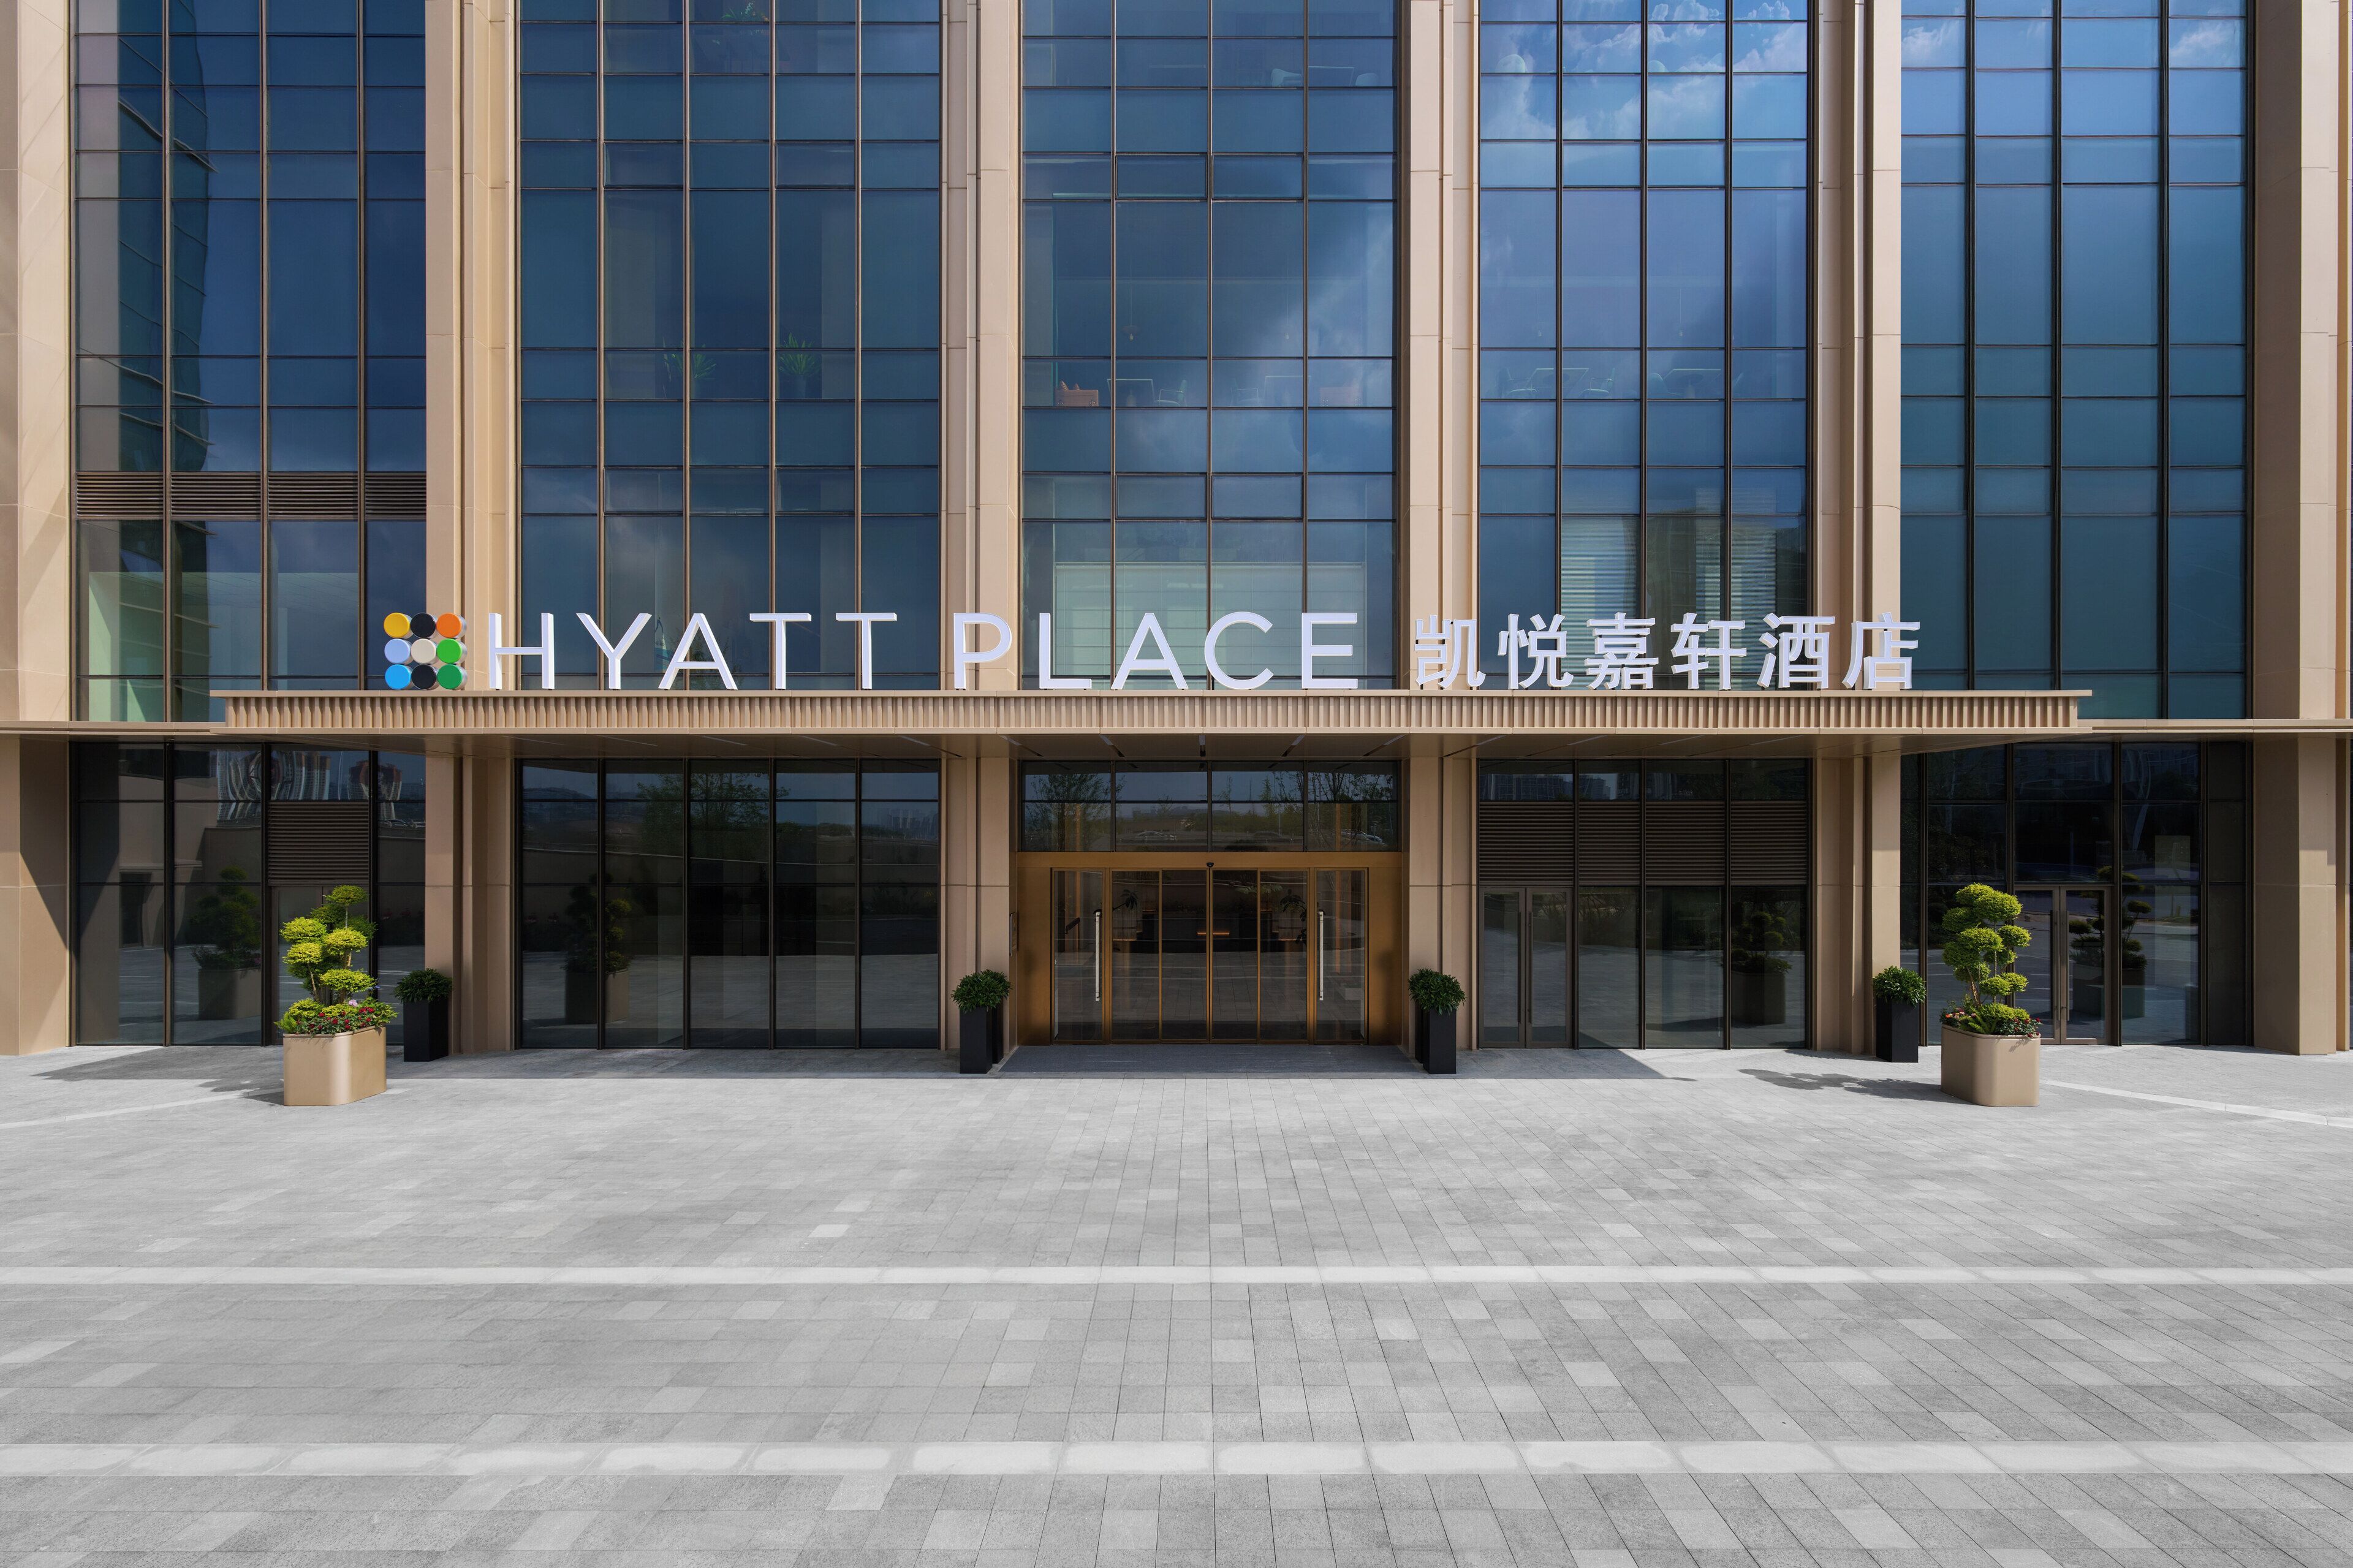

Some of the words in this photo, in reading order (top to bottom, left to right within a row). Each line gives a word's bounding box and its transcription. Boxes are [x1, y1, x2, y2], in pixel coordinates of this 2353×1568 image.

[490, 613, 897, 690] HYATT
[953, 612, 1358, 689] PLACE
[1414, 612, 1921, 690] 凯悦嘉轩酒店
